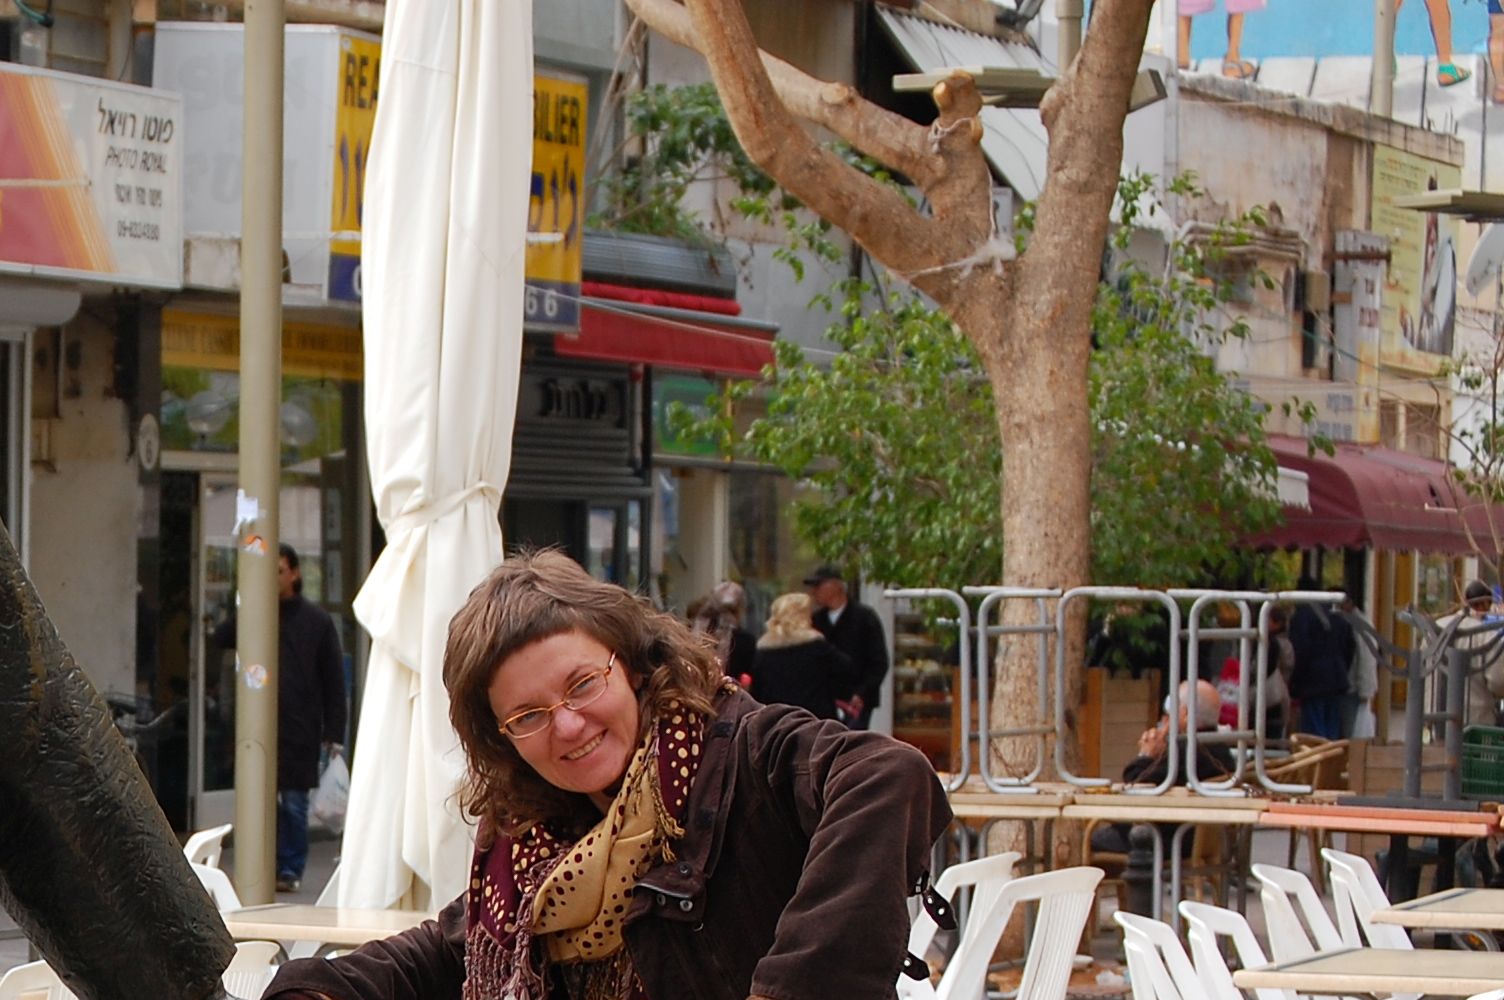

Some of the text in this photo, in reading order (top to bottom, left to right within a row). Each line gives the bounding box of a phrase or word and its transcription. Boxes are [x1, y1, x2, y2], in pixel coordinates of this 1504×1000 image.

[141, 114, 174, 143] פוטו
[104, 146, 167, 174] PHOTO ROYAL
